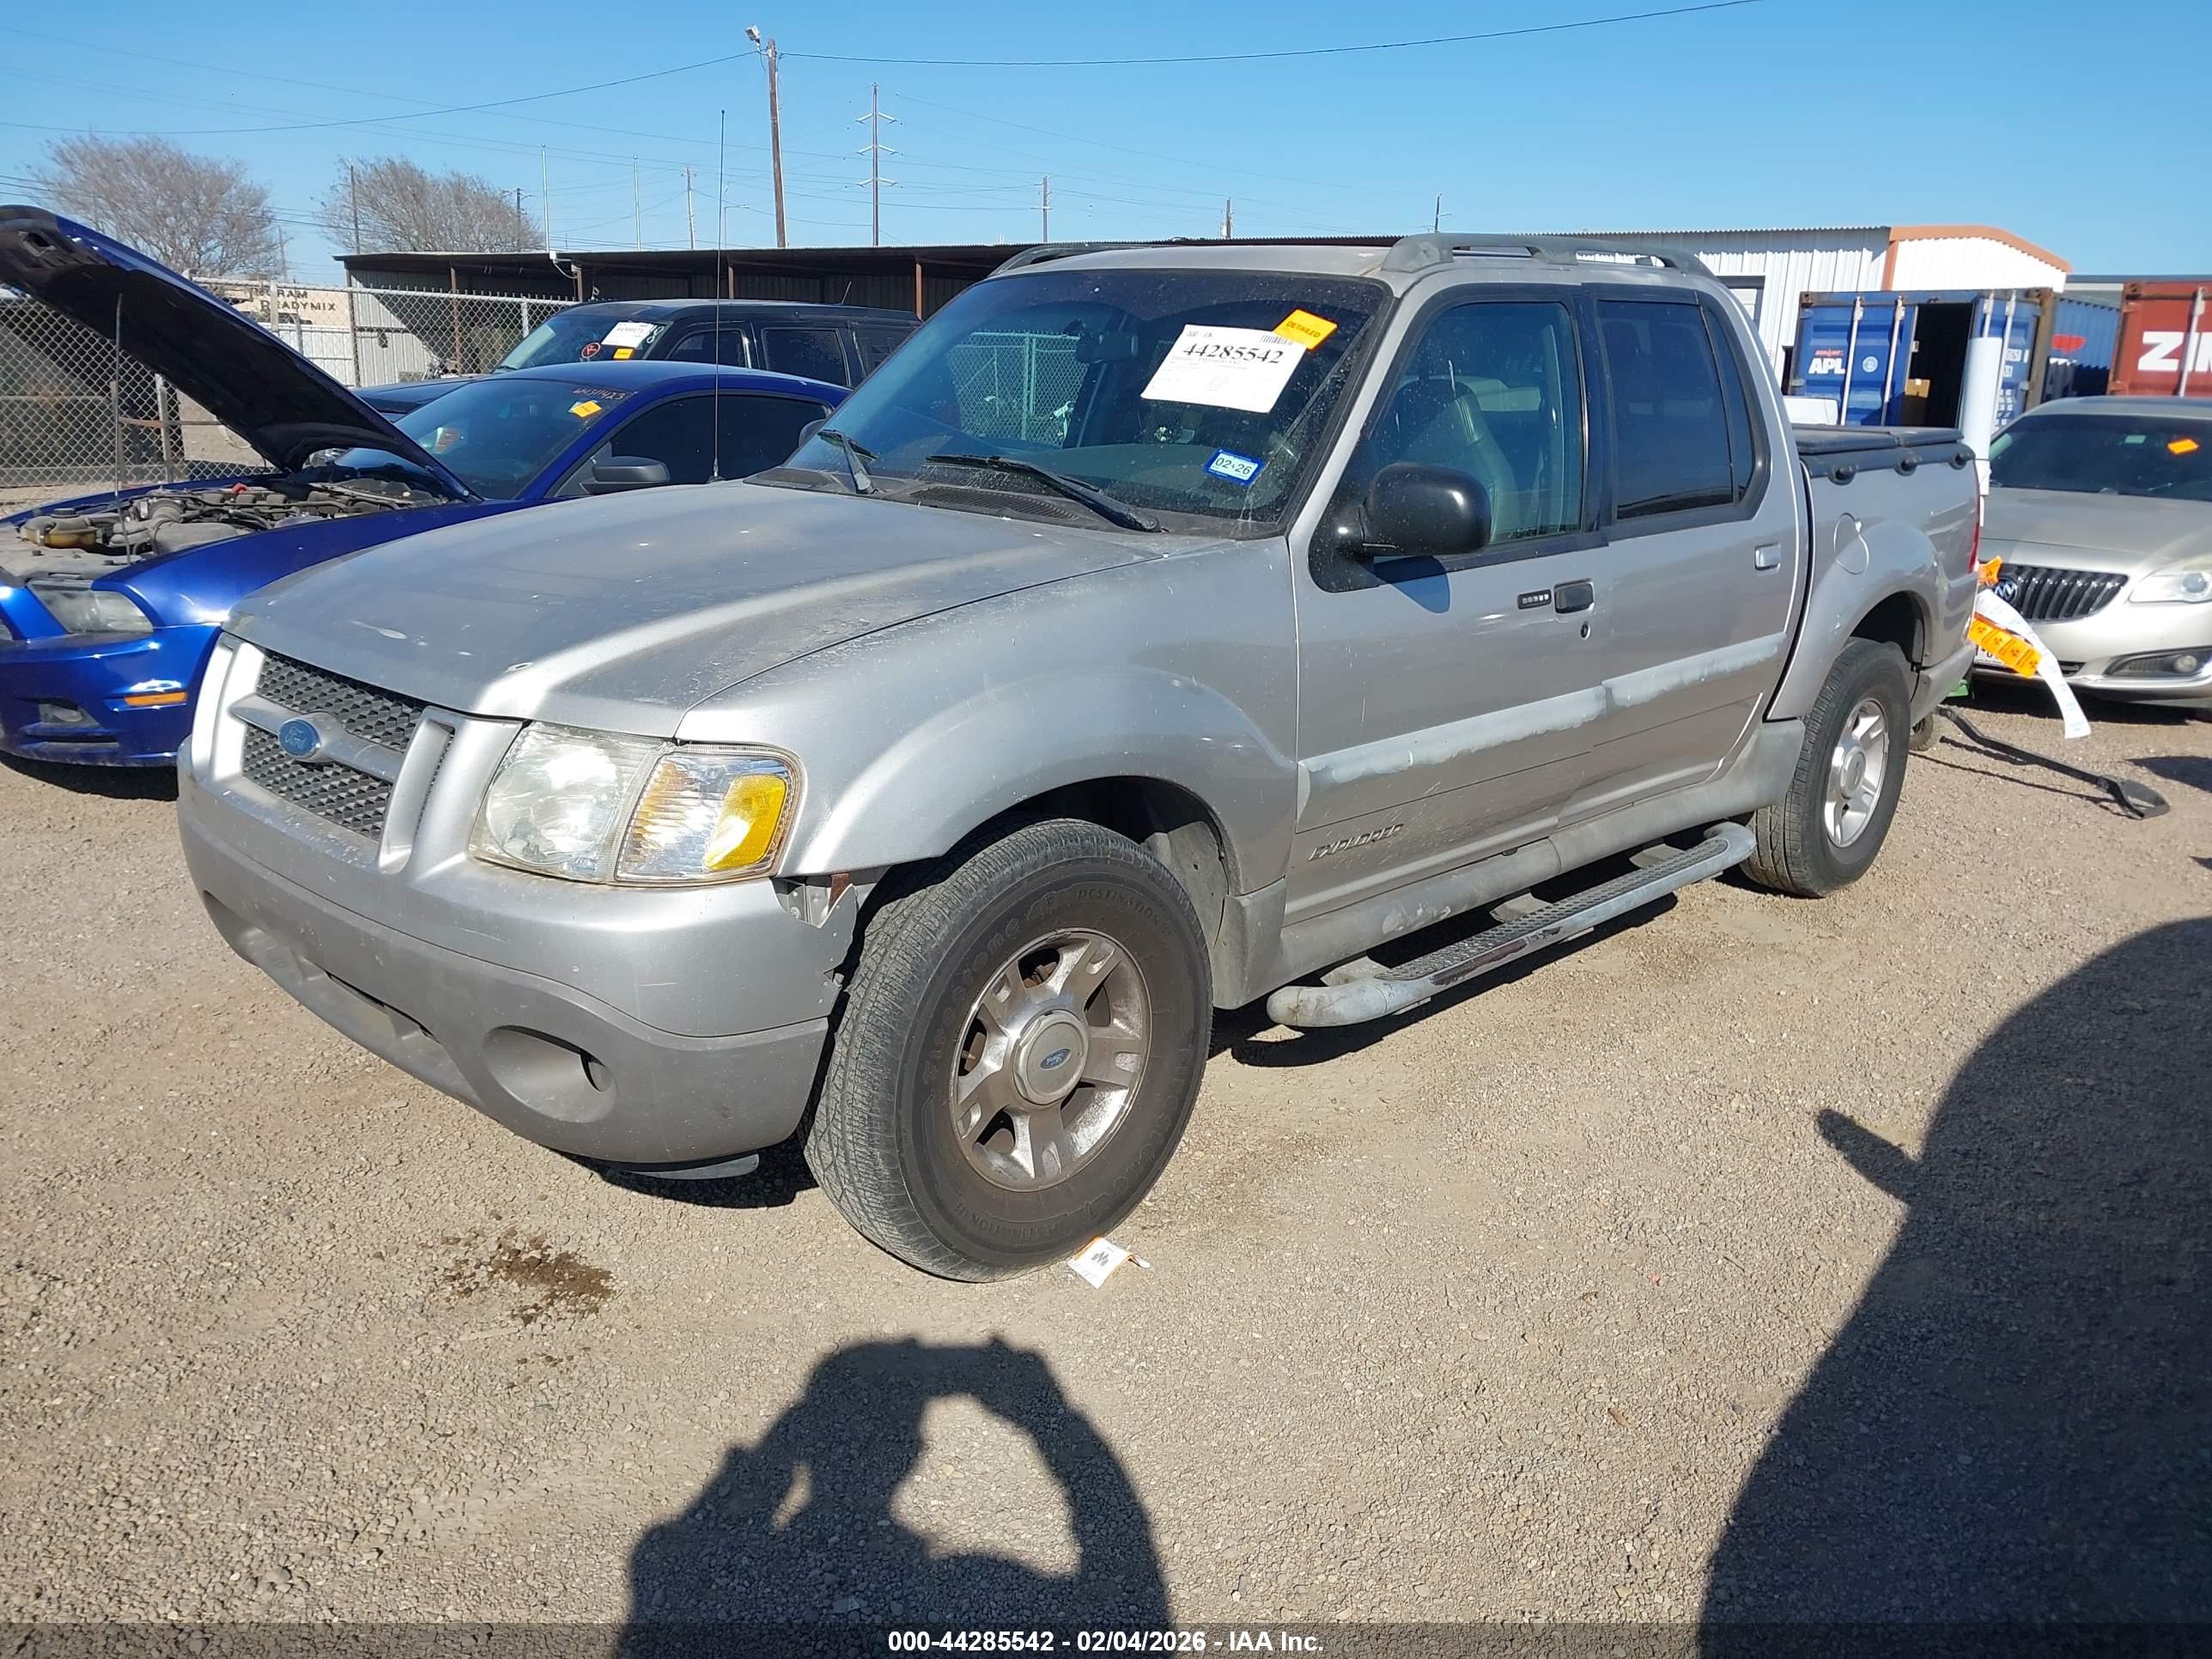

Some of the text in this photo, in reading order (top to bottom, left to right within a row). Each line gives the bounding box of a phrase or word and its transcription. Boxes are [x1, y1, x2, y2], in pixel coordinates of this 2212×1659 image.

[259, 300, 337, 311] READYMIX
[1285, 320, 1322, 338] DETAILED
[1182, 343, 1284, 364] 44285542
[1808, 357, 1846, 374] APL
